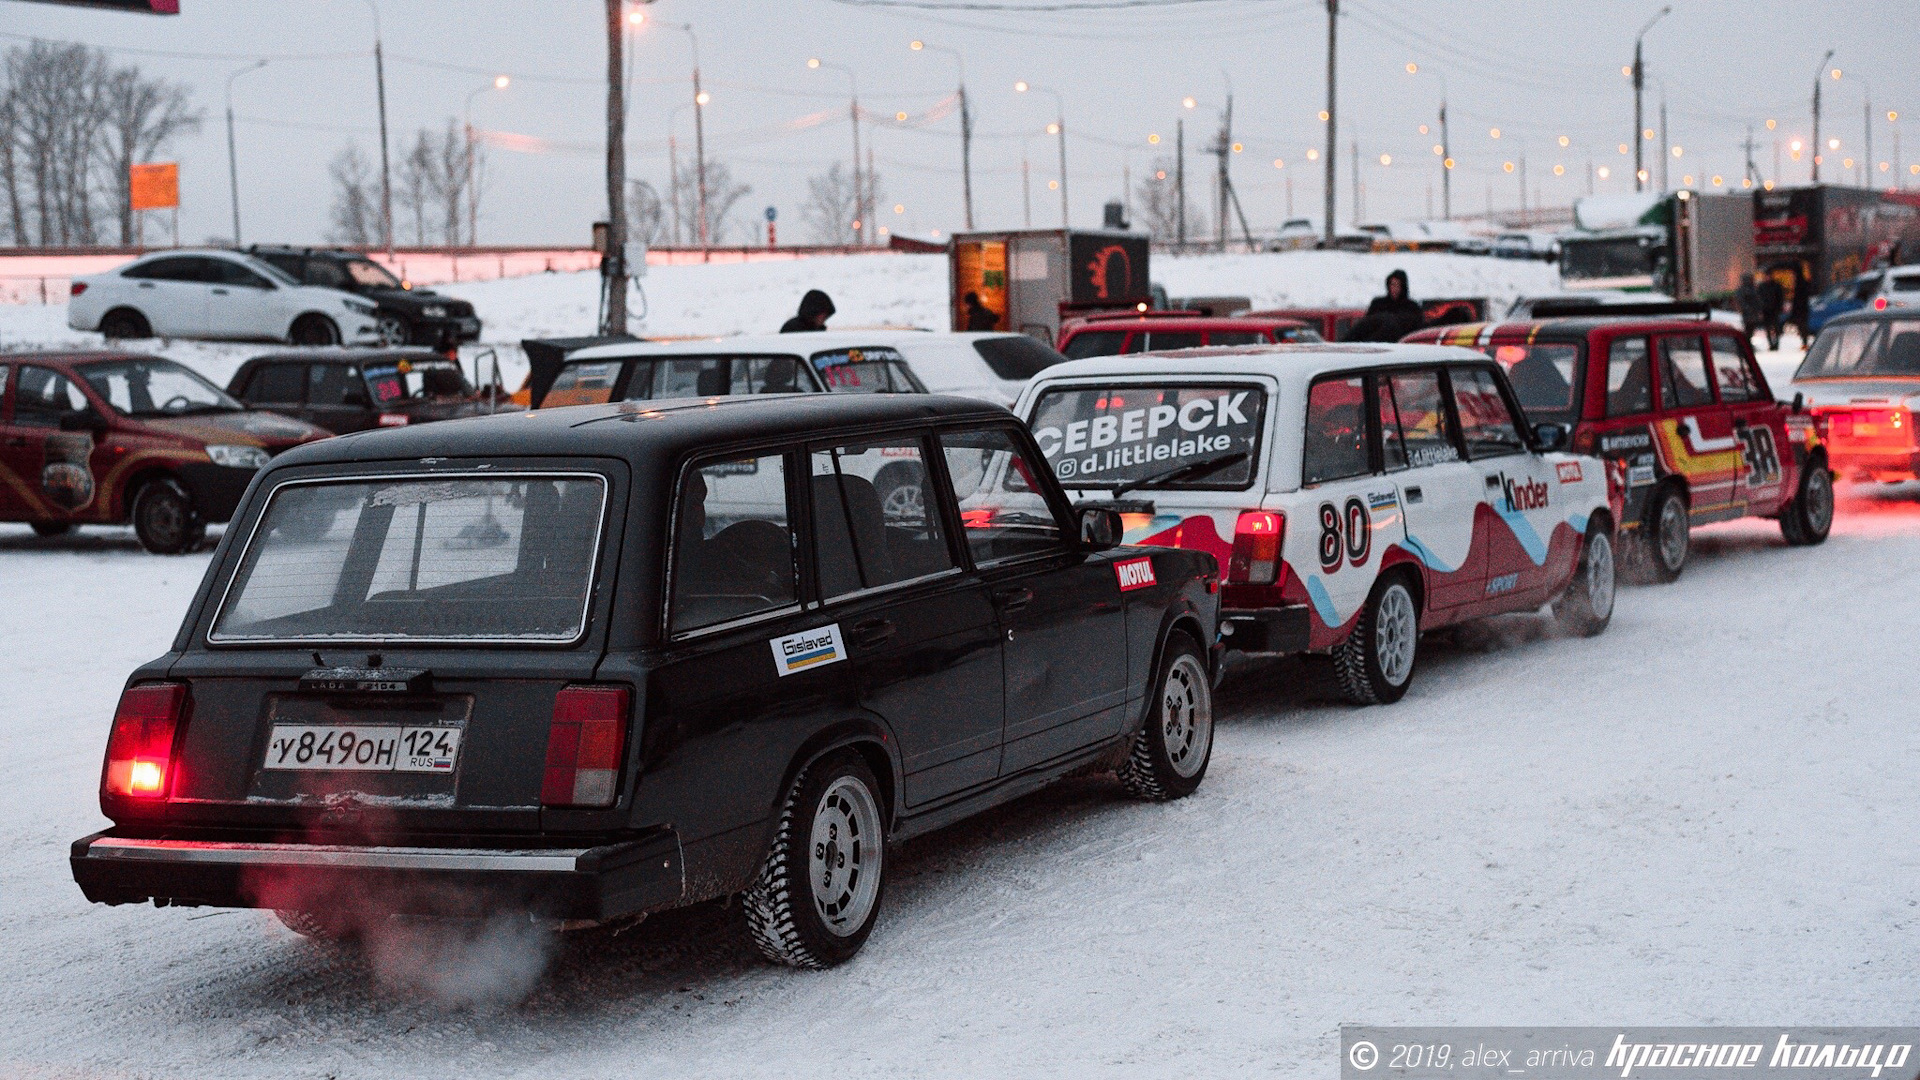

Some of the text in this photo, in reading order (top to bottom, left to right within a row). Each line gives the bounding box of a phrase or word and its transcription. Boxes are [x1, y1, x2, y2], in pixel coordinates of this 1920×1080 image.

[1034, 392, 1249, 459] СЕВЕРСК
[1081, 434, 1231, 474] d.littlelake
[1500, 471, 1549, 512] Kinder
[1319, 495, 1371, 574] 80
[1118, 561, 1154, 588] MOTUL
[782, 630, 833, 656] Gislaved
[404, 731, 450, 757] 124
[410, 757, 433, 768] RUS
